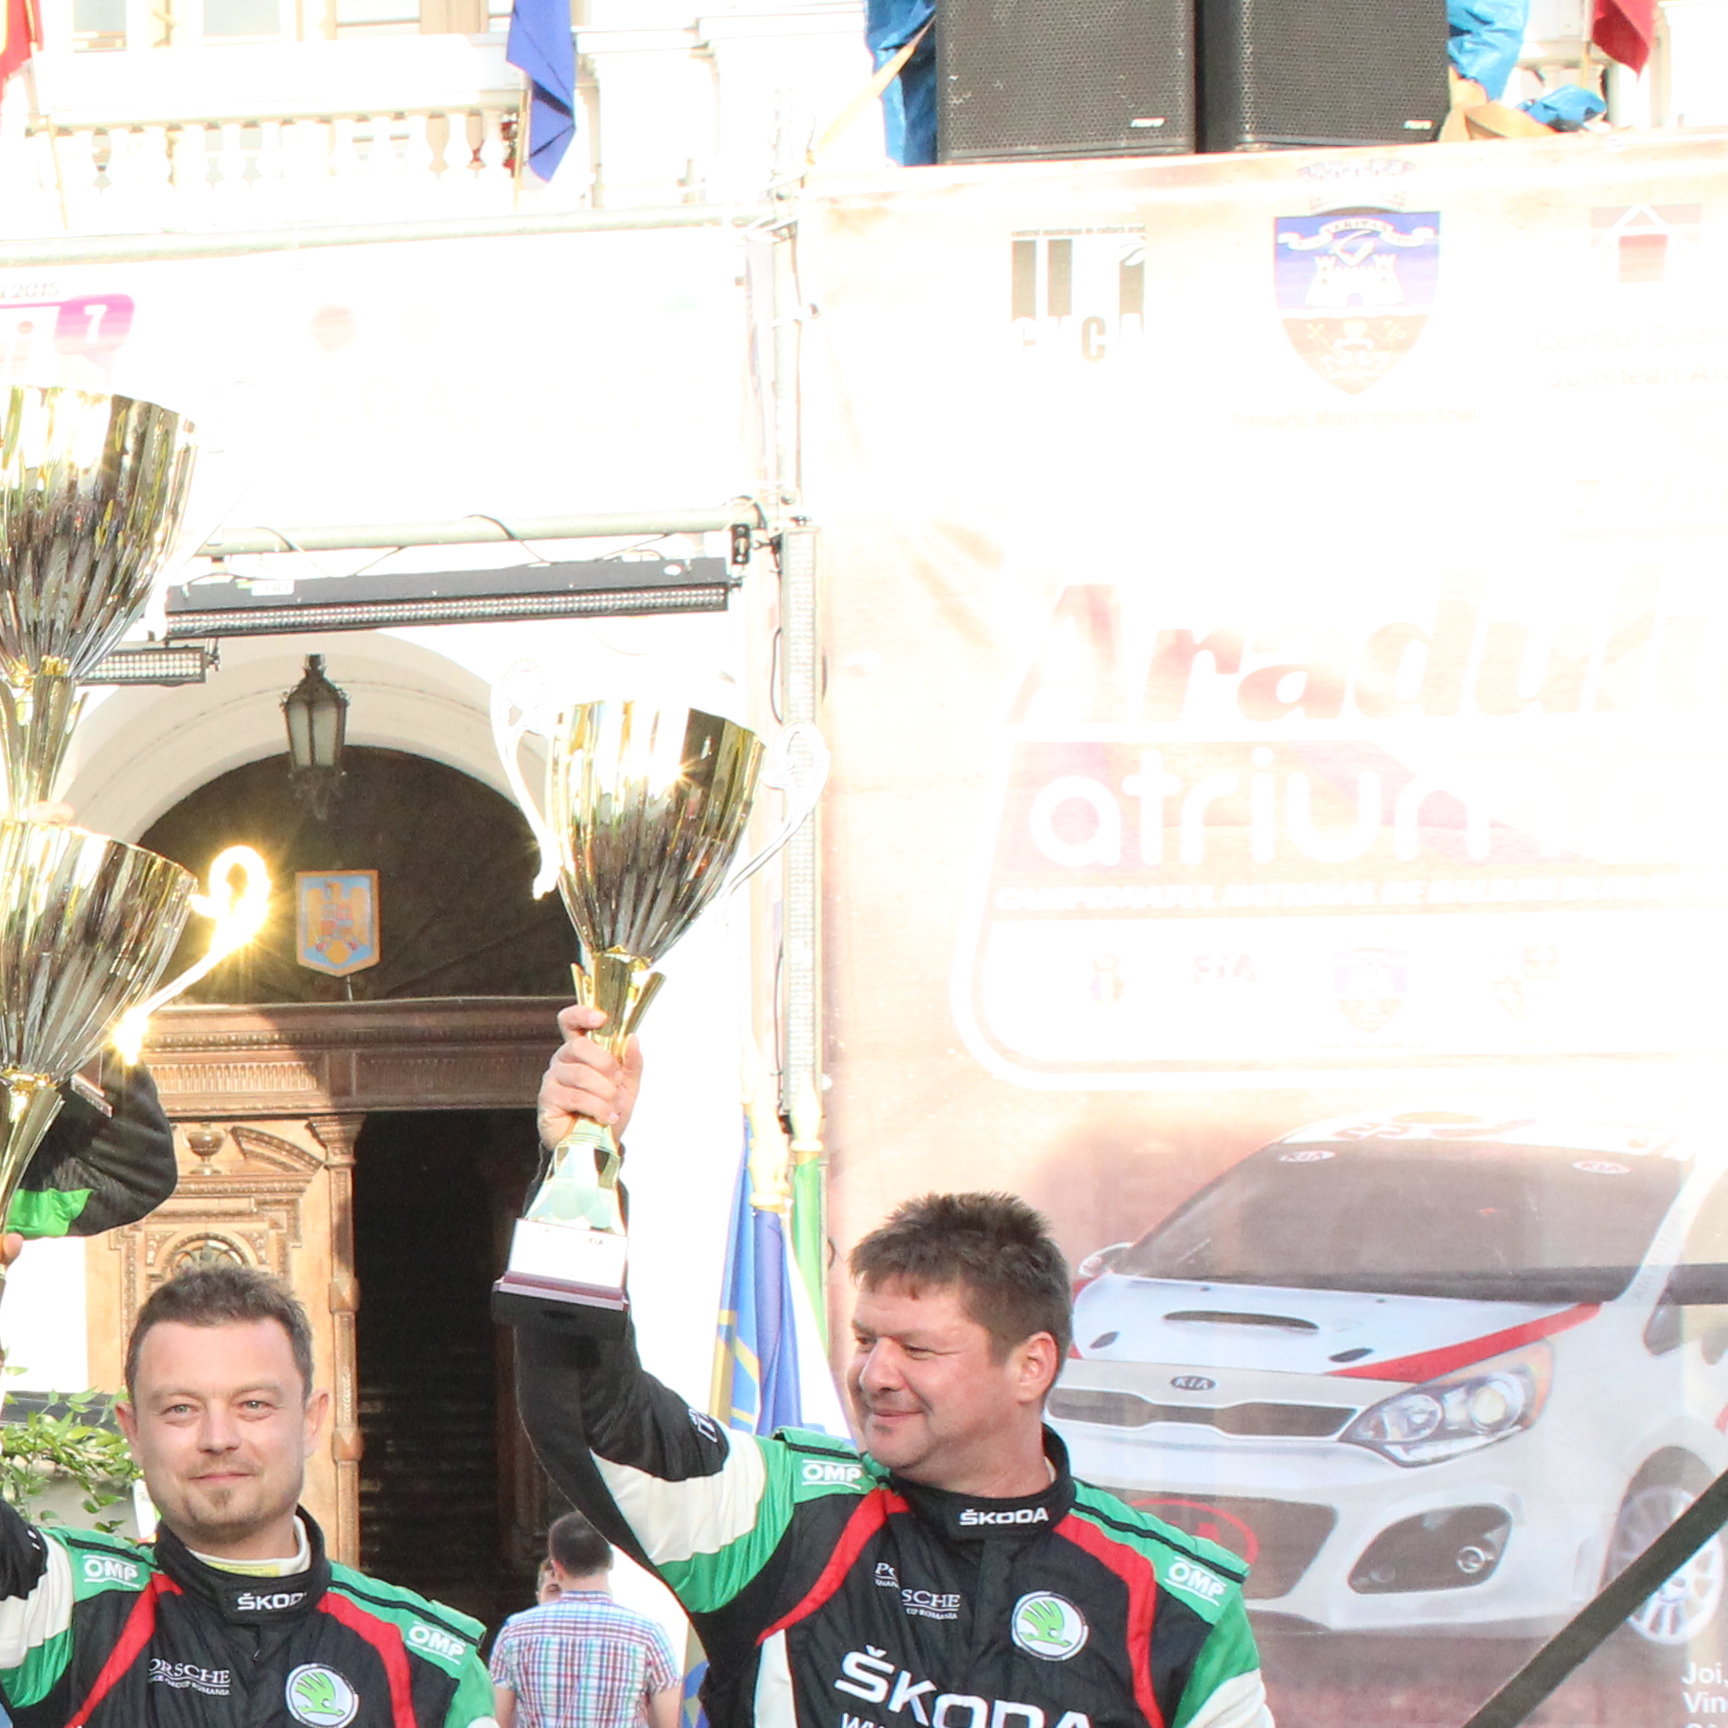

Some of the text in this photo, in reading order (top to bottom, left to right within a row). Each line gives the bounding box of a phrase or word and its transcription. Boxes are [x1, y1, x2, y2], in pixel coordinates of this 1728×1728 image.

[11, 281, 60, 298] 2015
[84, 305, 107, 344] 7
[1175, 1376, 1213, 1390] KIA
[802, 1464, 863, 1482] OMP
[959, 1506, 1050, 1527] ŠKODA
[83, 1558, 138, 1581] OMP
[1168, 1560, 1225, 1598] OMP
[409, 1626, 464, 1656] OMP
